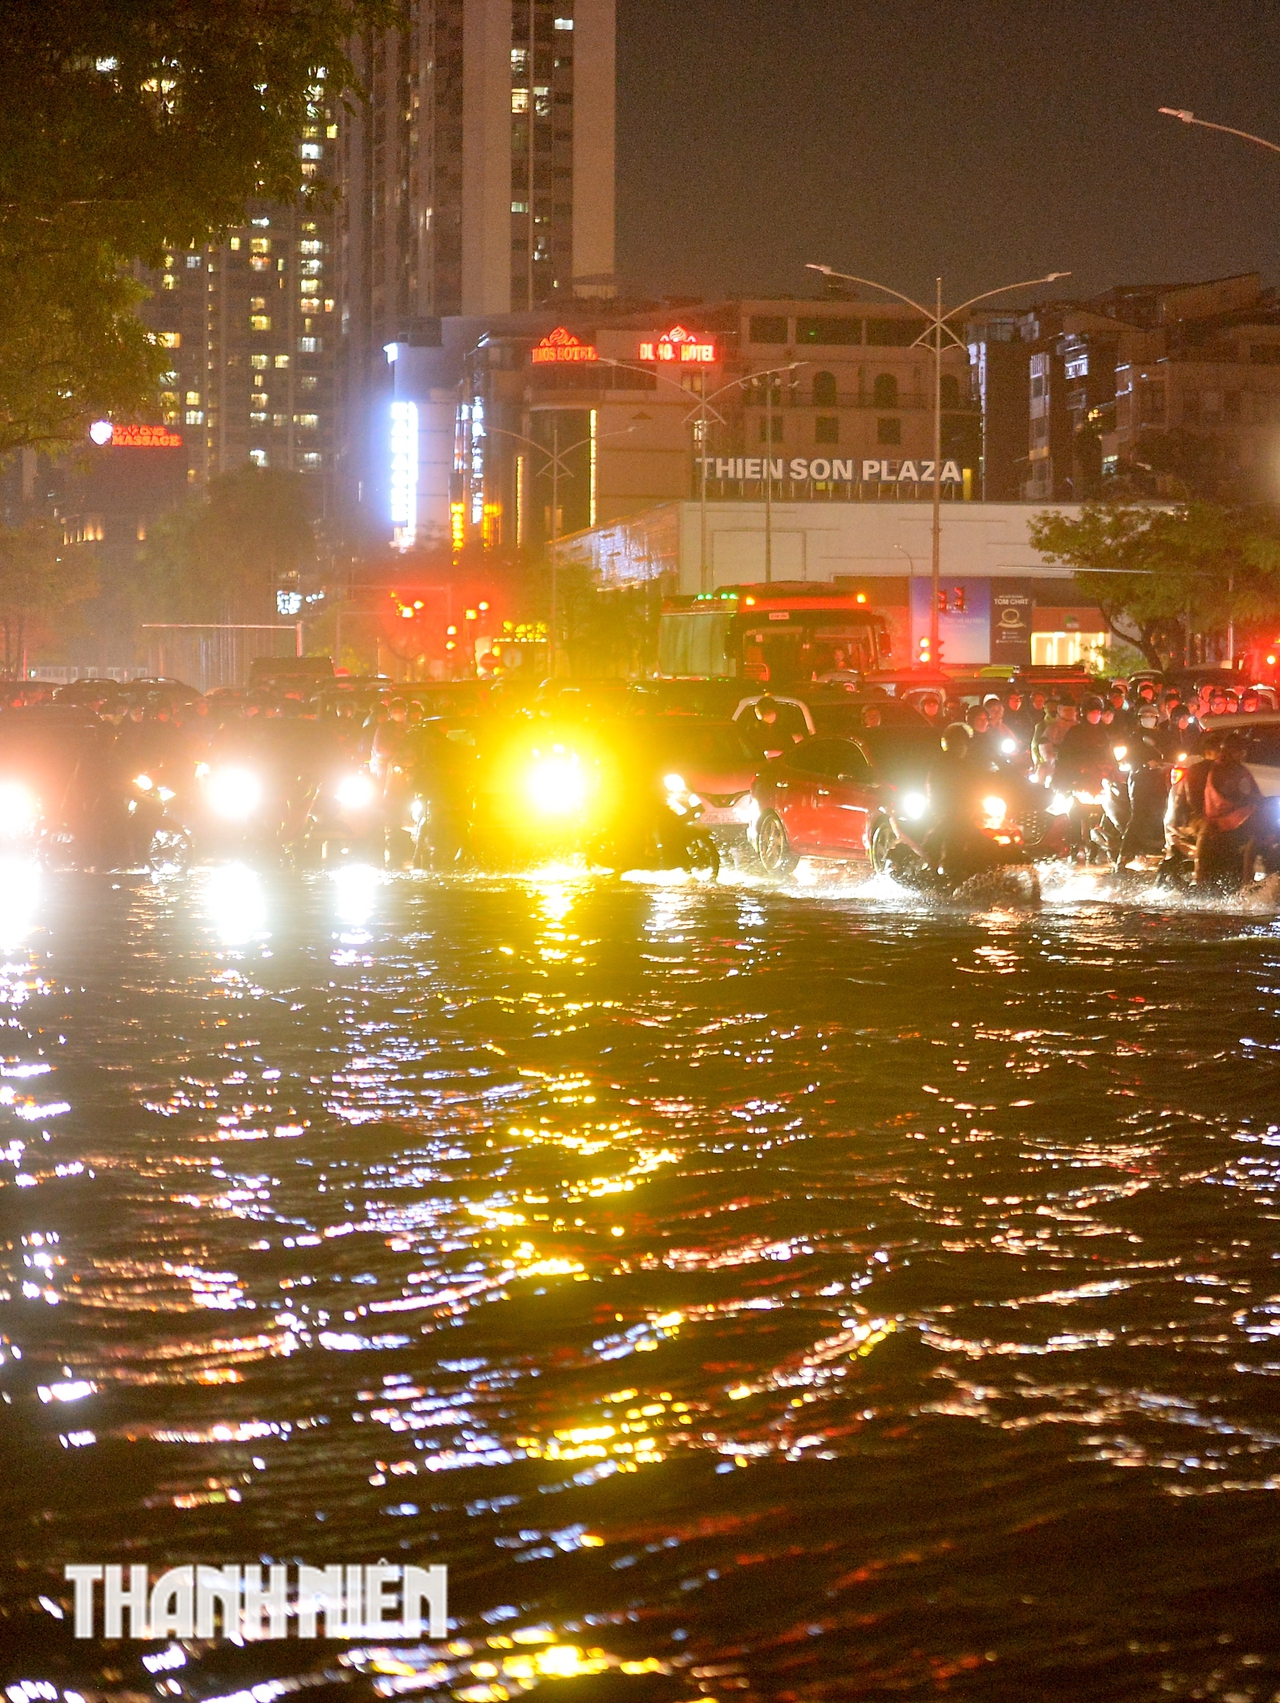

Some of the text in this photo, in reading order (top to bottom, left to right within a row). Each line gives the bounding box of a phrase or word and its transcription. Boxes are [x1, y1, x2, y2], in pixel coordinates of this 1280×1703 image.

[681, 344, 716, 362] HOTEL
[112, 435, 179, 446] MASSAGE
[695, 457, 962, 482] THIEN SON PLAZA
